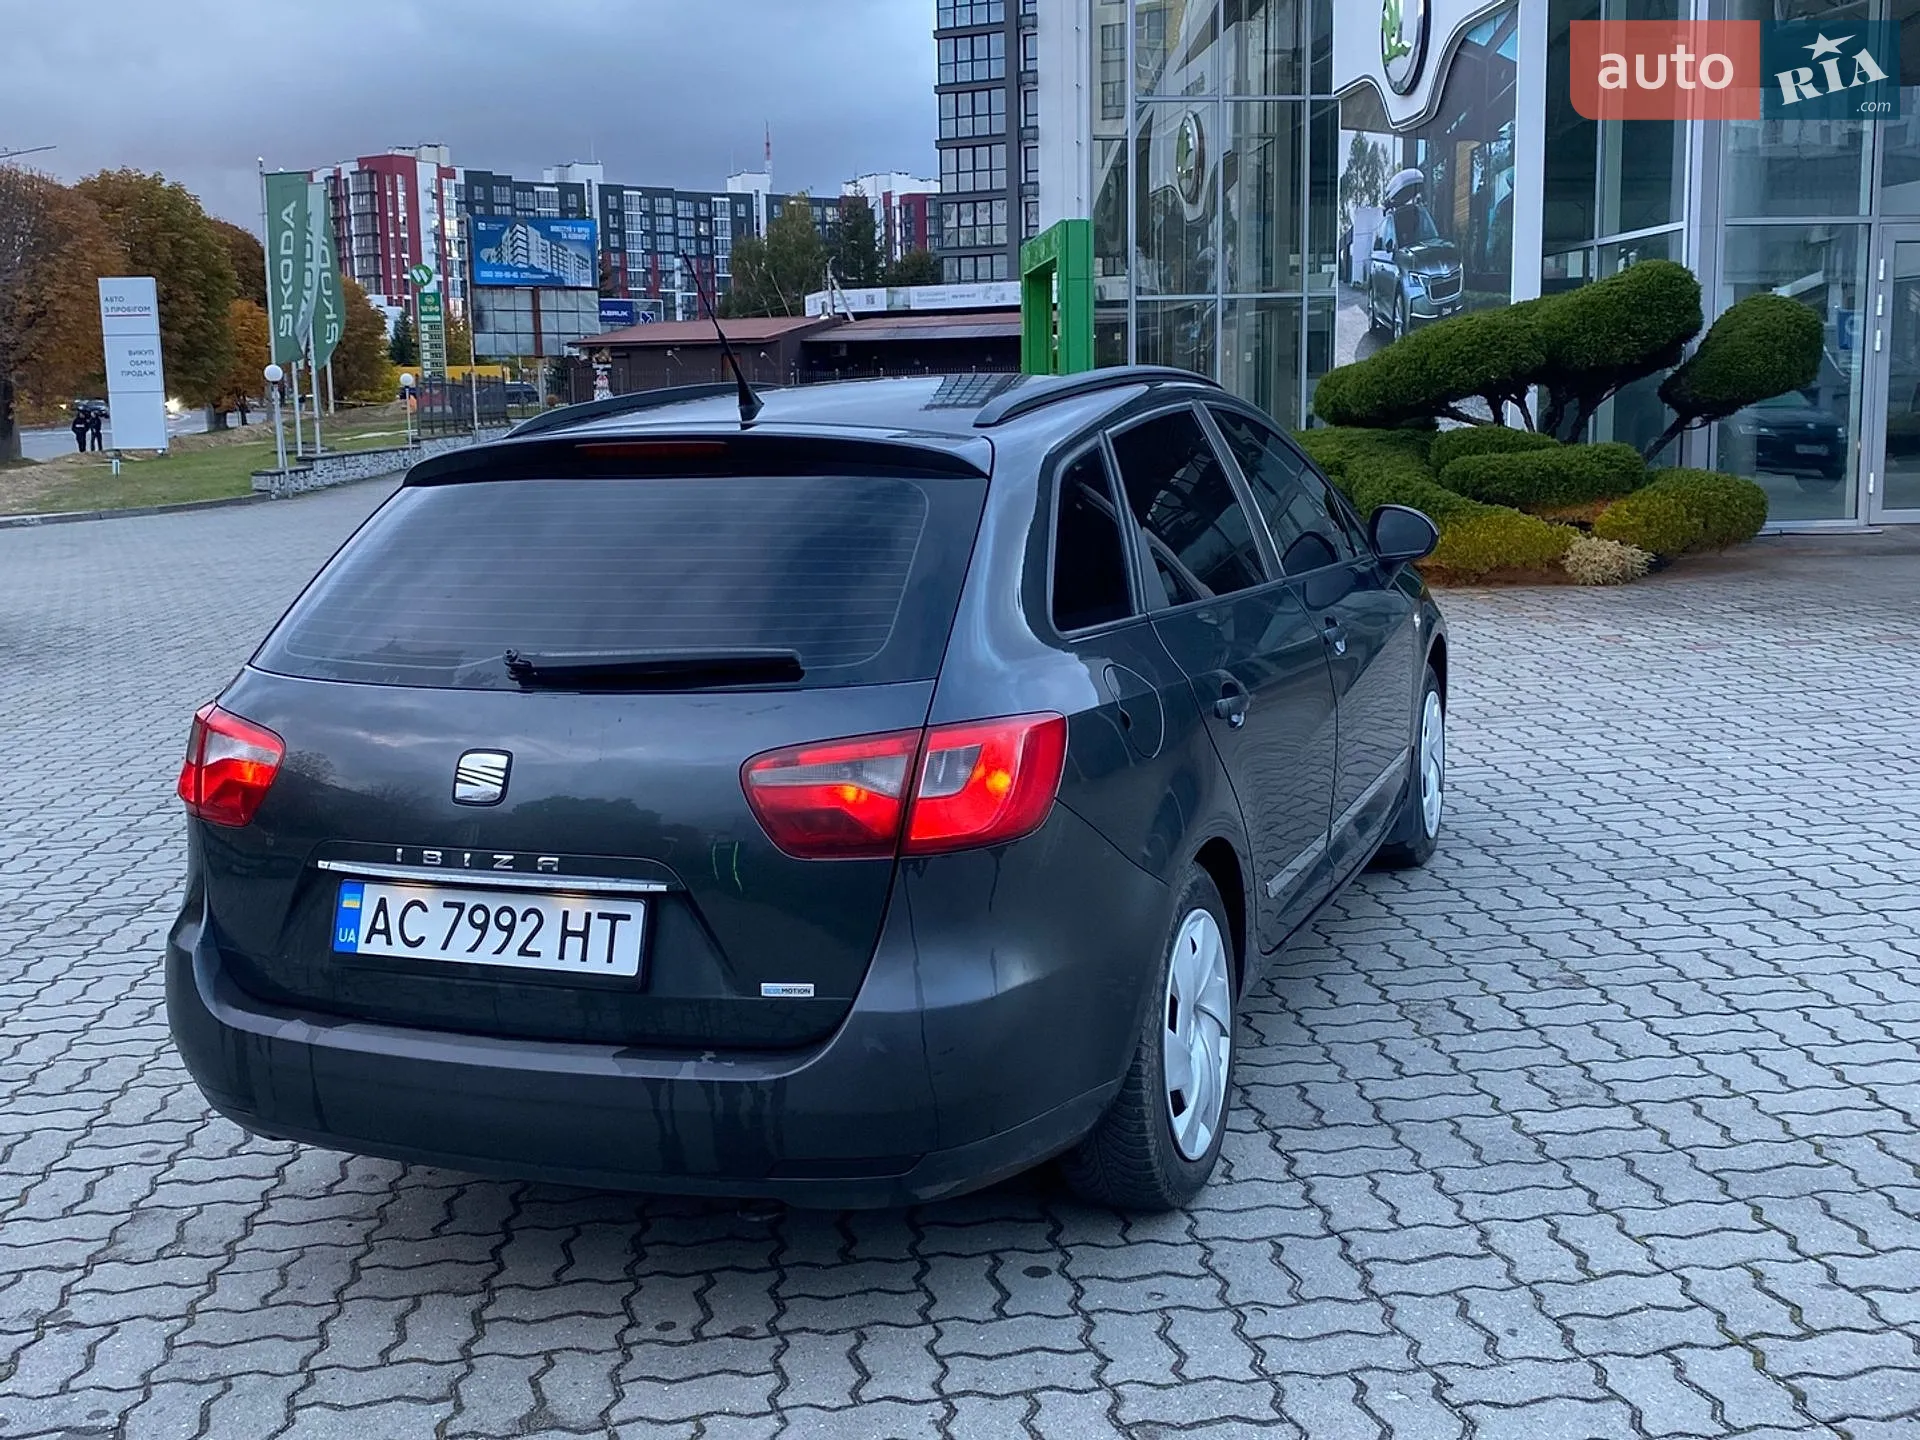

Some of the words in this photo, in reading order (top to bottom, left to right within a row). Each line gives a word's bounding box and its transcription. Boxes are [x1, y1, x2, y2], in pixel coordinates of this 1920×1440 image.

[396, 848, 560, 872] IBIZA
[338, 927, 356, 944] UA
[364, 897, 429, 948] AC
[440, 901, 545, 958] 7992
[557, 910, 632, 964] HT
